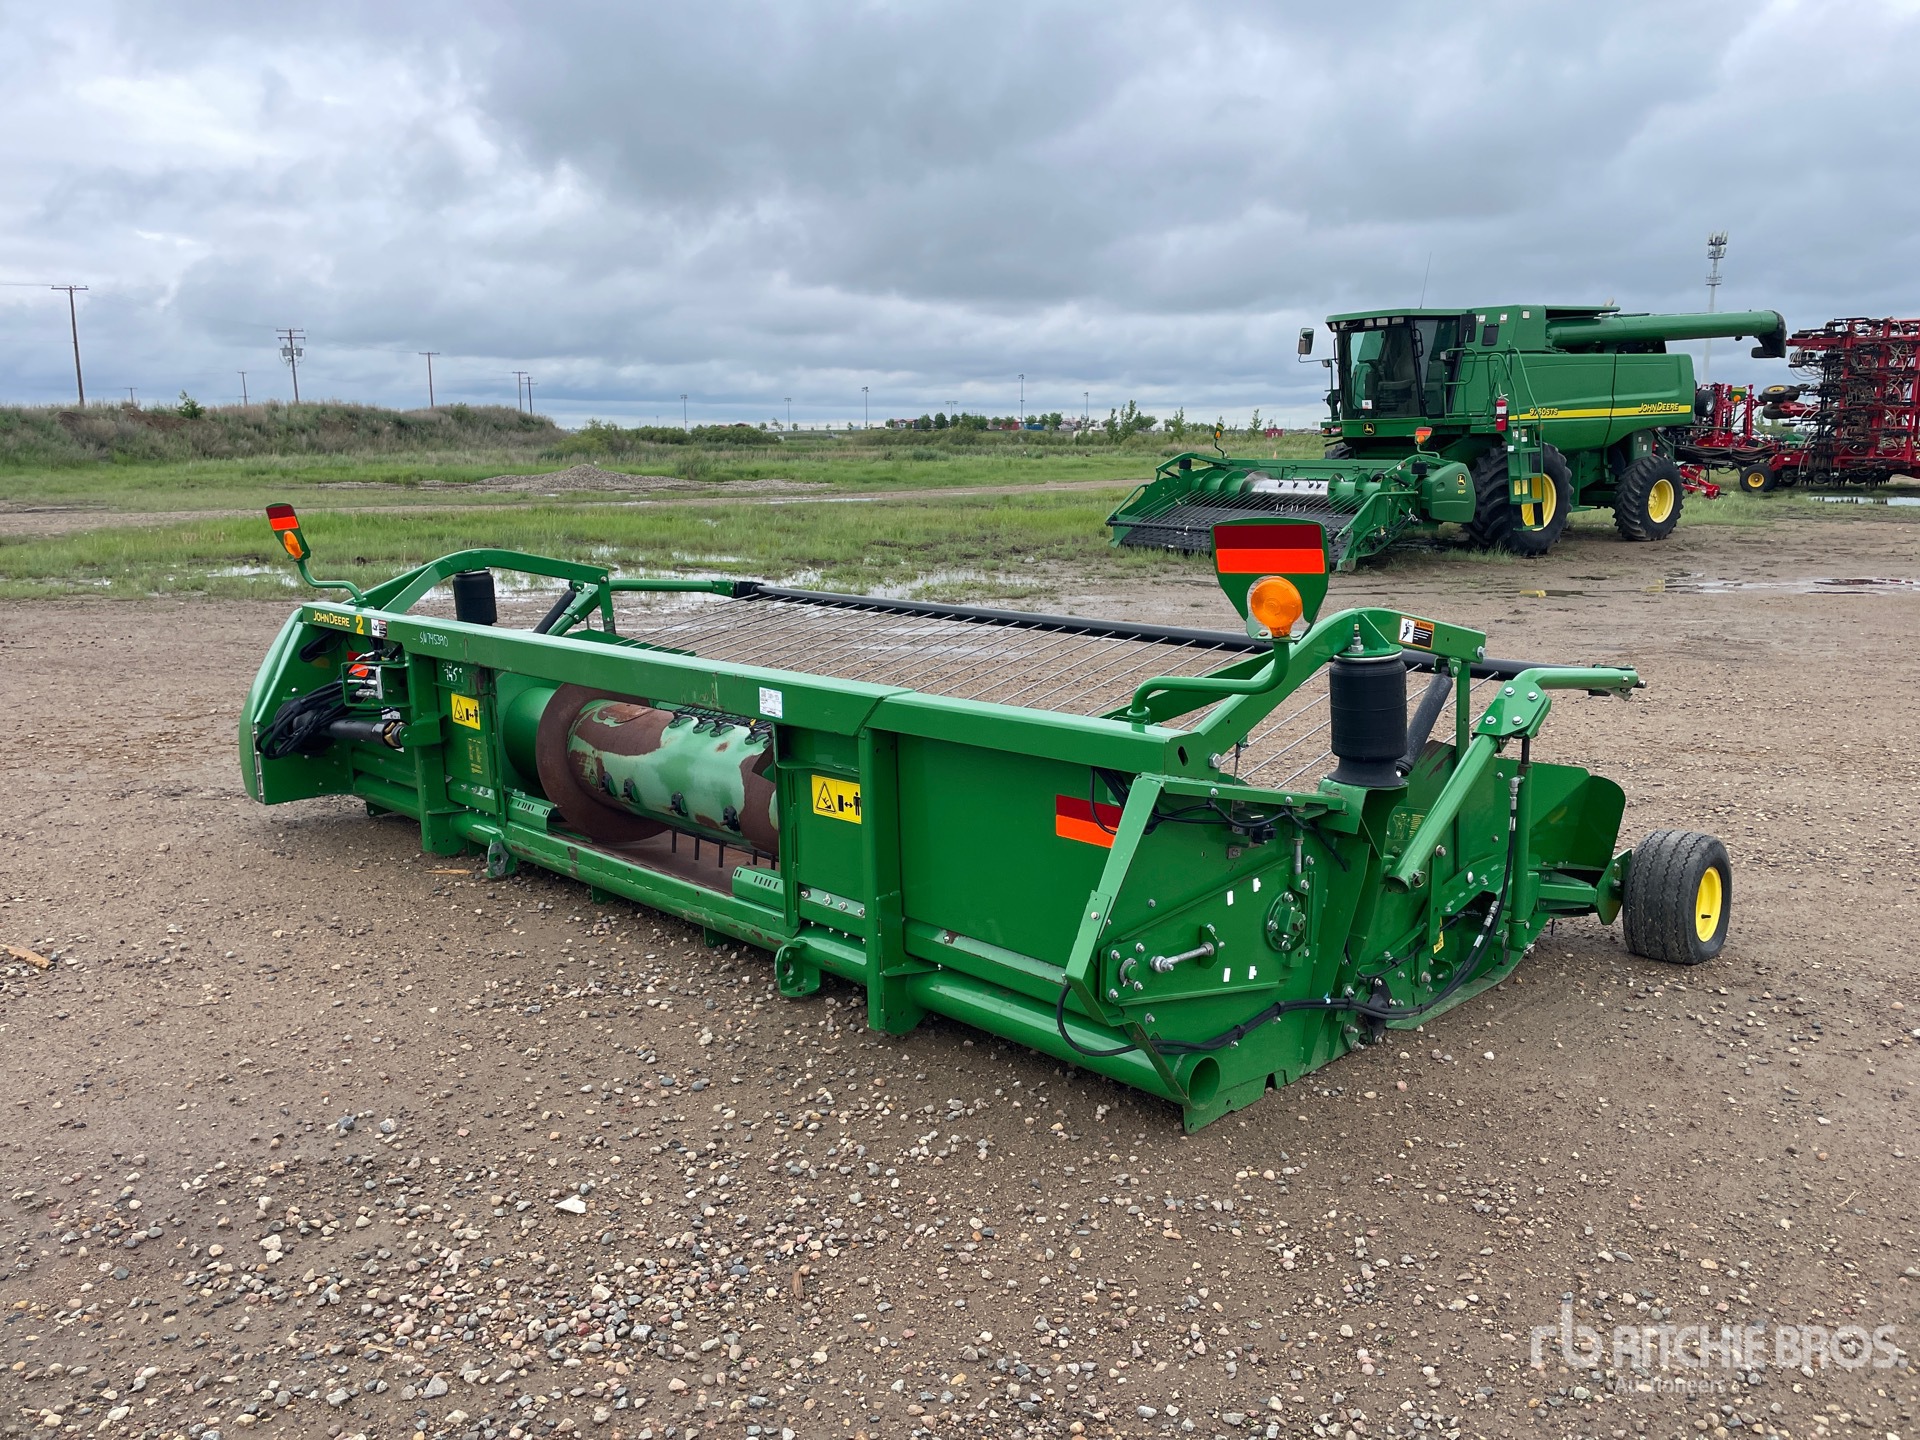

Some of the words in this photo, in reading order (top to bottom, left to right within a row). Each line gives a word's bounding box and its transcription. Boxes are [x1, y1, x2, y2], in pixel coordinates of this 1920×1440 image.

[1638, 402, 1657, 413] JOHN
[1657, 401, 1680, 412] DEERE
[313, 610, 330, 624] JOHN
[329, 613, 350, 627] DEERE
[355, 614, 364, 635] 2
